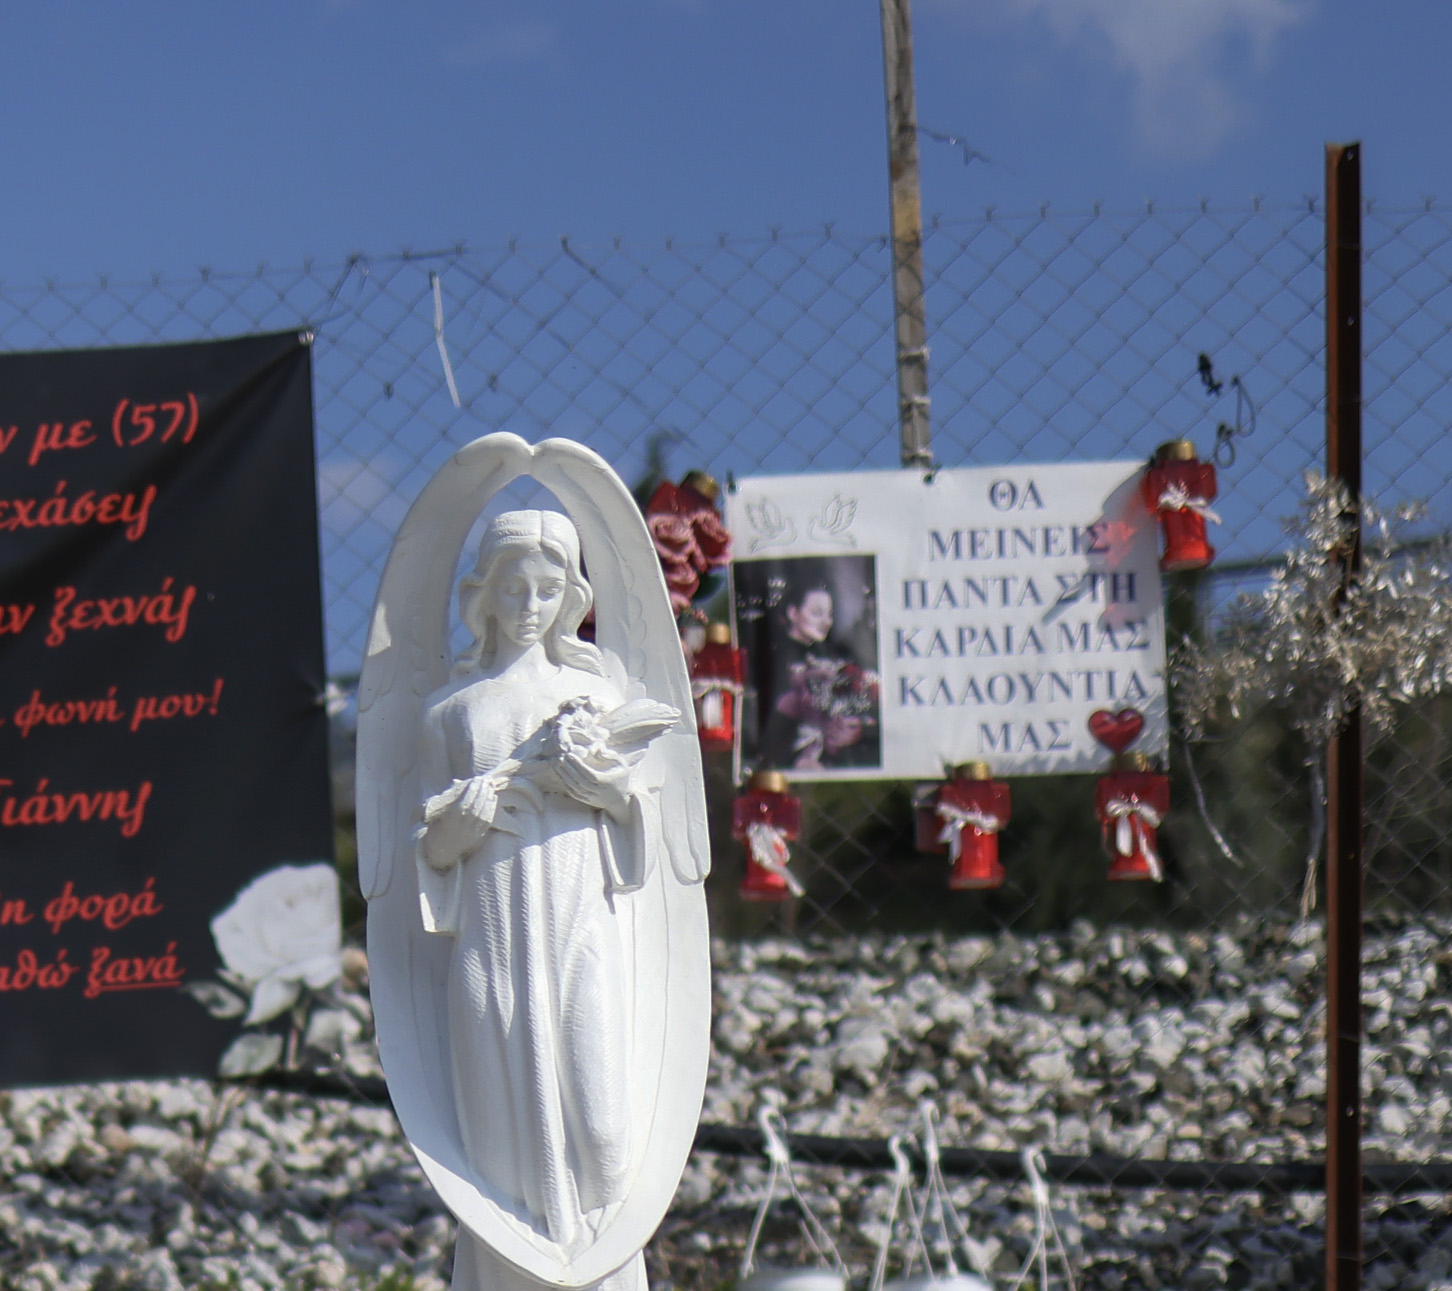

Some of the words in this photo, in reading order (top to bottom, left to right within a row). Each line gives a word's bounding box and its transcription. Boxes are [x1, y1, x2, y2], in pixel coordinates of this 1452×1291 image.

[29, 421, 96, 466] με
[112, 393, 198, 446] (57)
[990, 480, 1044, 510] ΘΑ
[930, 524, 1110, 562] ΜΕΙΝΕΙΣ
[904, 578, 1041, 610] ΠΑΝΤΑ
[1055, 571, 1136, 603] ΣΤΗ
[46, 577, 196, 646] ξεχνάς
[894, 626, 1044, 658] ΚΑΡΔΙΑ
[1058, 622, 1150, 652] ΜΑΣ
[14, 687, 122, 737] φωνή
[131, 679, 224, 731] μου!
[899, 671, 1150, 706] ΚΛΑΟΥΝΤΙΑ
[978, 721, 1073, 753] ΜΑΣ
[44, 878, 162, 933] φορά
[84, 942, 184, 998] ξανά
